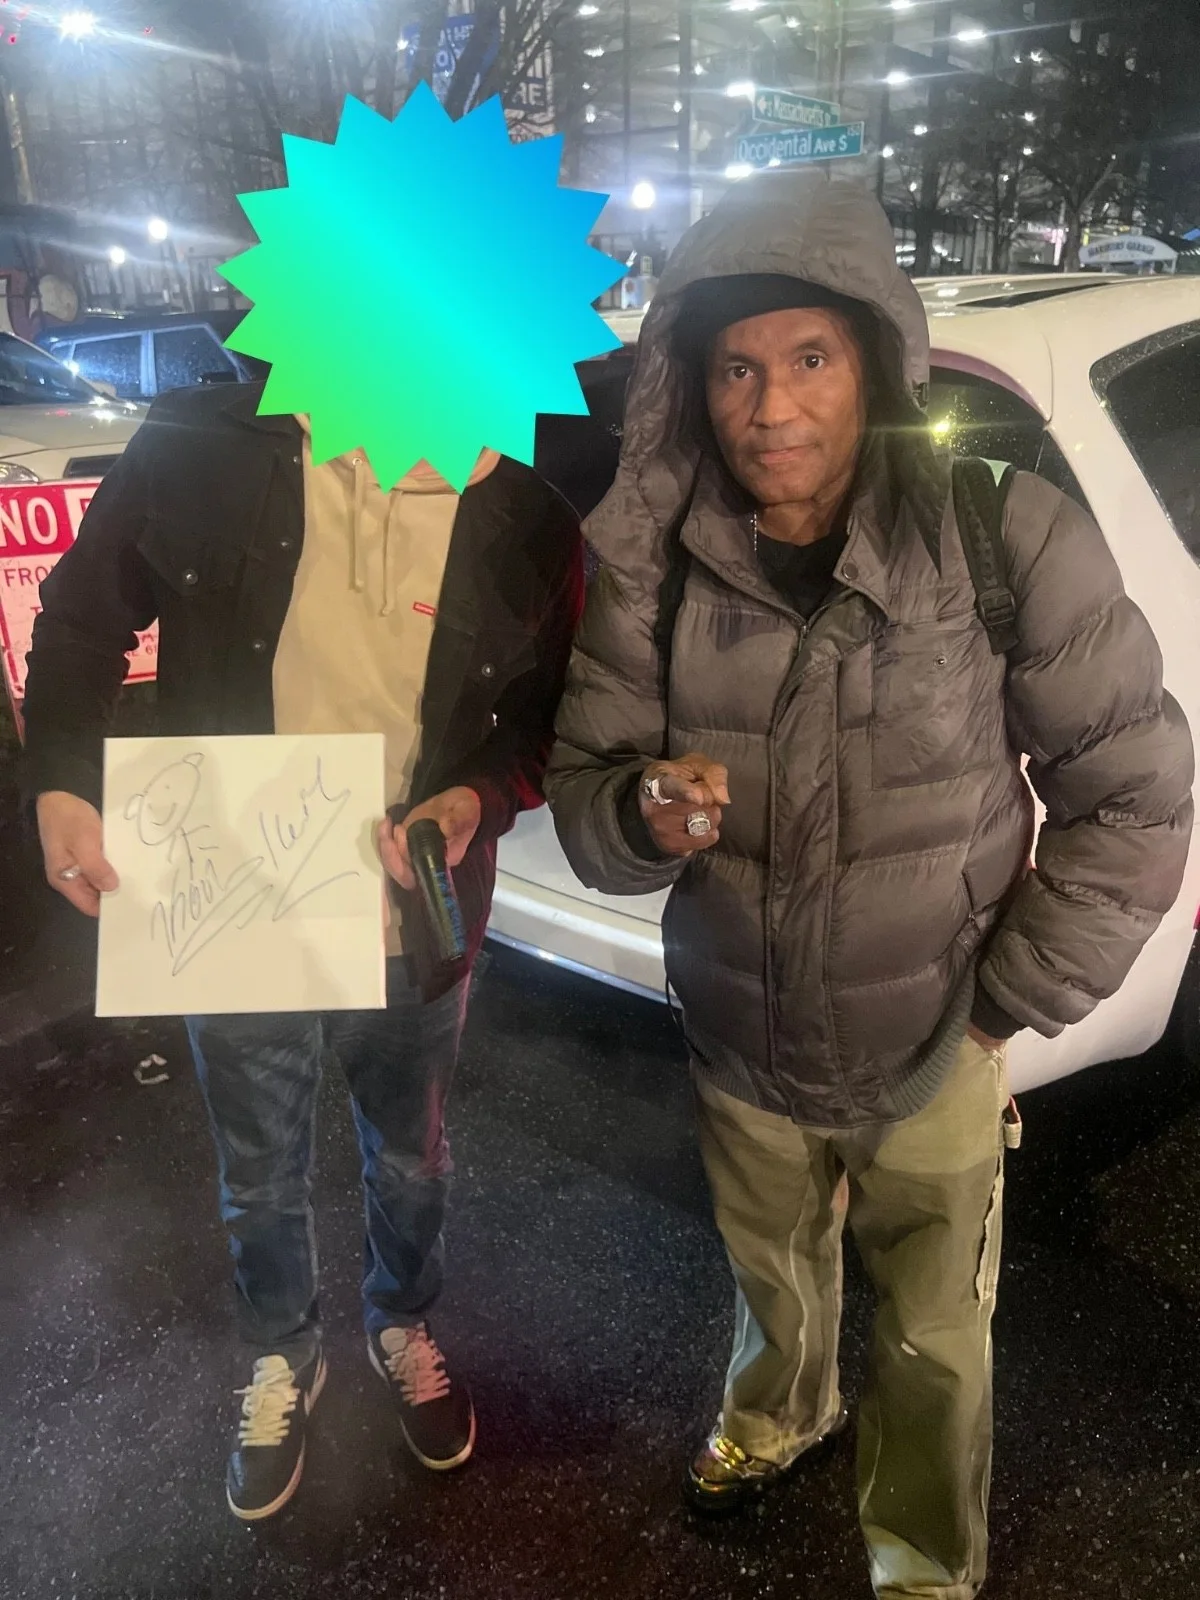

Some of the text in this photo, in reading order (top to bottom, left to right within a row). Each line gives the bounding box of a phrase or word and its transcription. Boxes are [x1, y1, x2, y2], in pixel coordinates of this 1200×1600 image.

[738, 132, 848, 162] Occidental Ave S
[0, 496, 57, 545] NO
[4, 562, 53, 586] FRO
